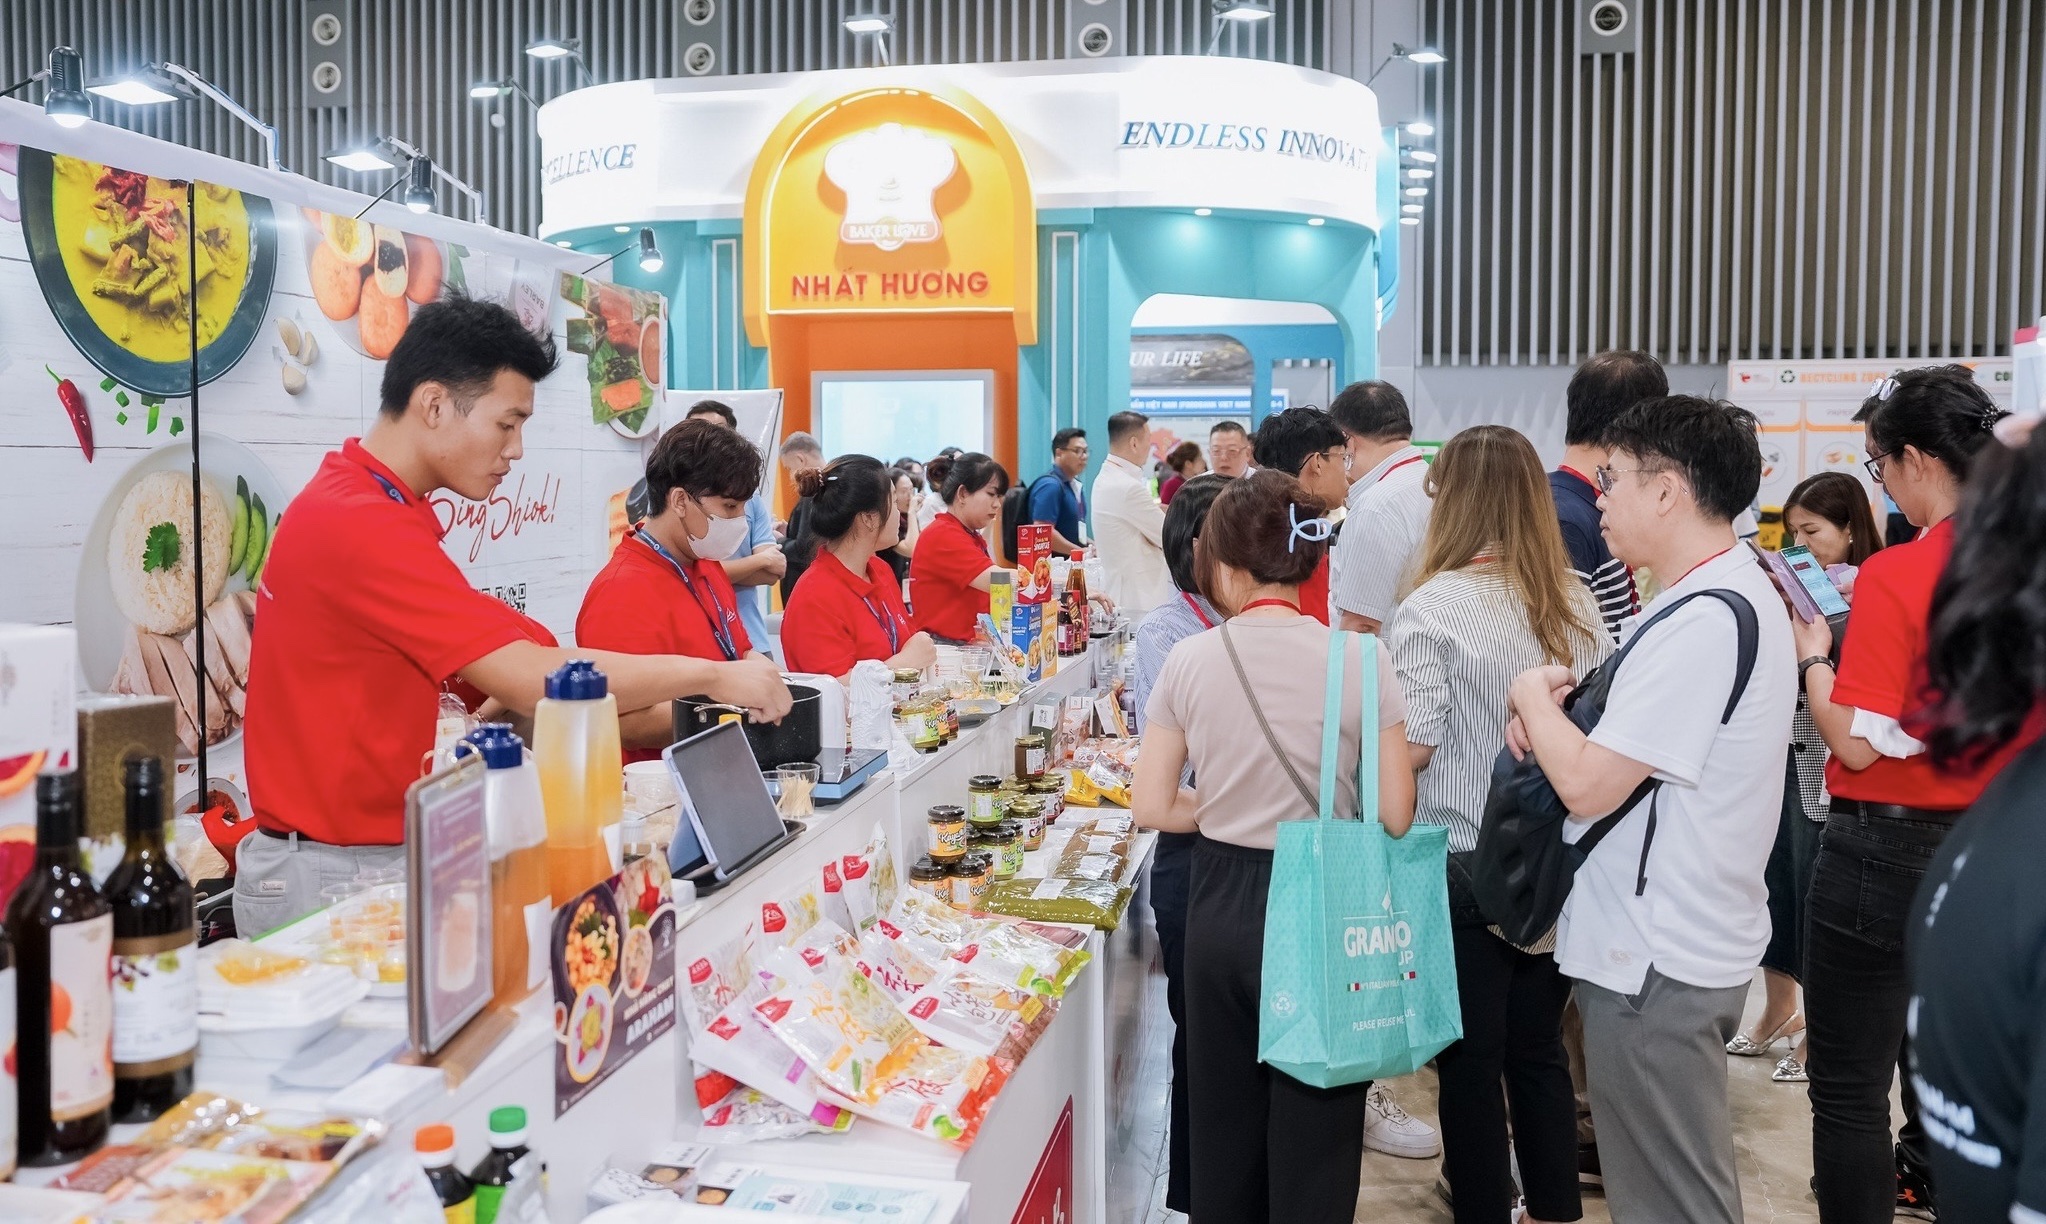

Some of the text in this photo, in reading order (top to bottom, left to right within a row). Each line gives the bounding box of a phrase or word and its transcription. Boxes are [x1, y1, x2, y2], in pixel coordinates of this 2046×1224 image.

[1117, 121, 1268, 151] ENDLESS
[850, 225, 890, 238] BAKER
[792, 267, 989, 296] NHẤT HƯƠNG
[1129, 350, 1203, 367] UR LIFE
[1800, 372, 1857, 383] RECYCLING
[1995, 371, 2013, 381] CO
[489, 473, 560, 541] Shiok!
[1344, 920, 1412, 957] GRANO
[1352, 1019, 1376, 1031] PLEASE
[1377, 1016, 1396, 1028] REUSE
